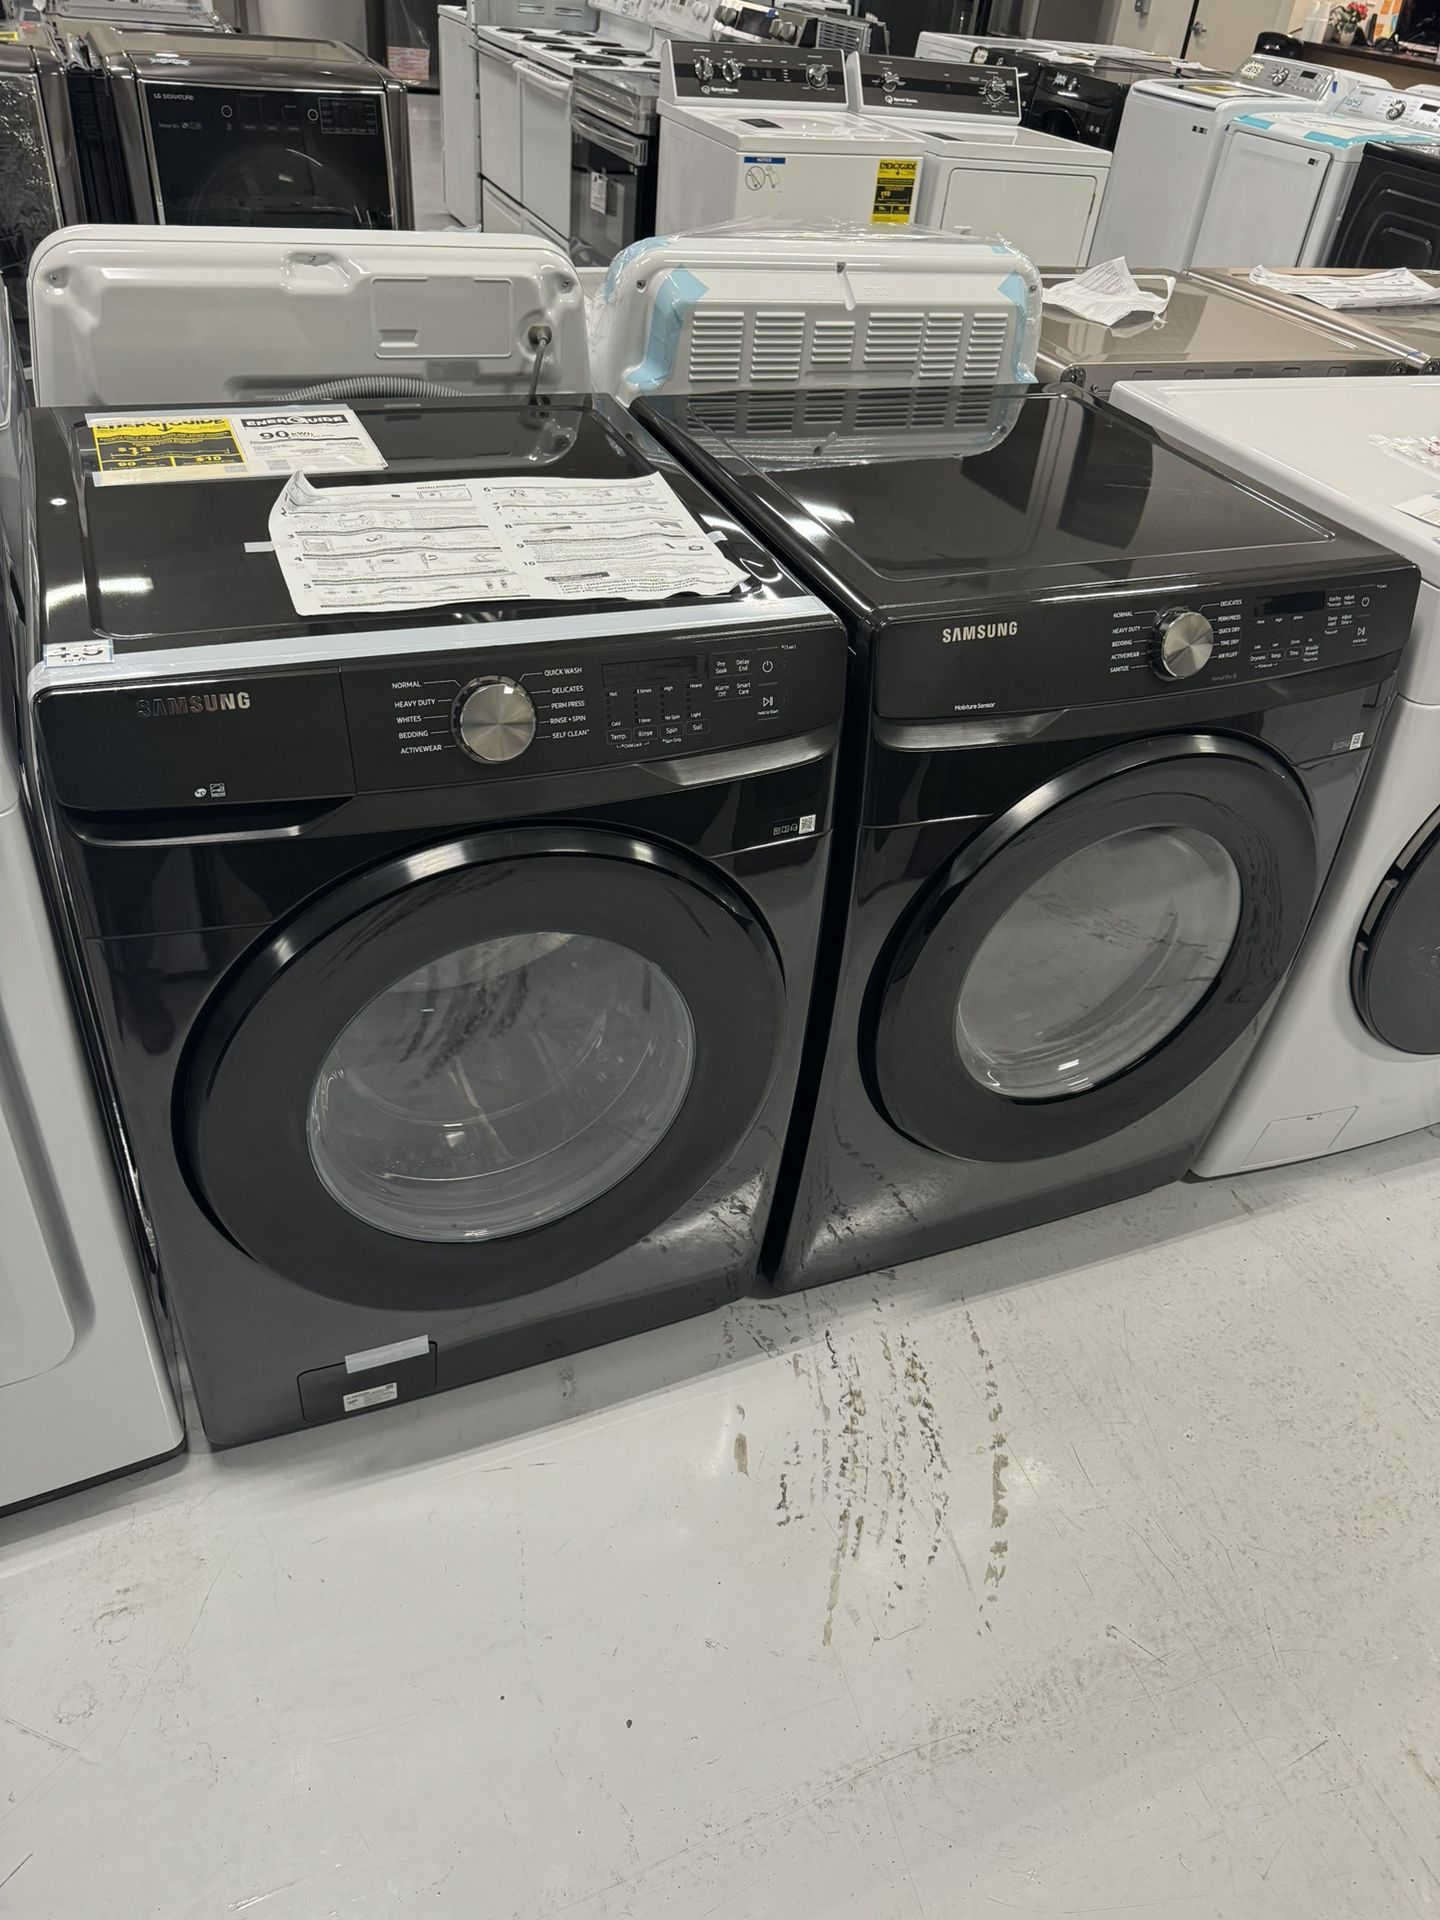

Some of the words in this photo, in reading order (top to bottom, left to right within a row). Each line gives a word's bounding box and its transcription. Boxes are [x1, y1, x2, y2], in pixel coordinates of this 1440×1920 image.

[260, 429, 290, 440] 90
[1220, 599, 1242, 607] DELICATES
[942, 621, 1018, 643] SAMSUNG
[1218, 627, 1231, 635] QUICK
[1111, 639, 1133, 647] BEDDING
[1111, 651, 1140, 660] ACTIVEWEAR
[544, 668, 563, 676] QUICK
[1110, 665, 1130, 673] SANITIZE
[392, 681, 422, 689] NORMAL
[552, 685, 584, 694] DELICATES
[137, 692, 251, 718] SAMSUNG
[395, 700, 417, 708] HEAVY
[396, 716, 422, 724] WHITES
[550, 716, 568, 724] RINSE
[692, 723, 703, 731] Soil
[398, 730, 429, 739] BEDDING
[401, 745, 442, 755] ACTIVEWEAR
